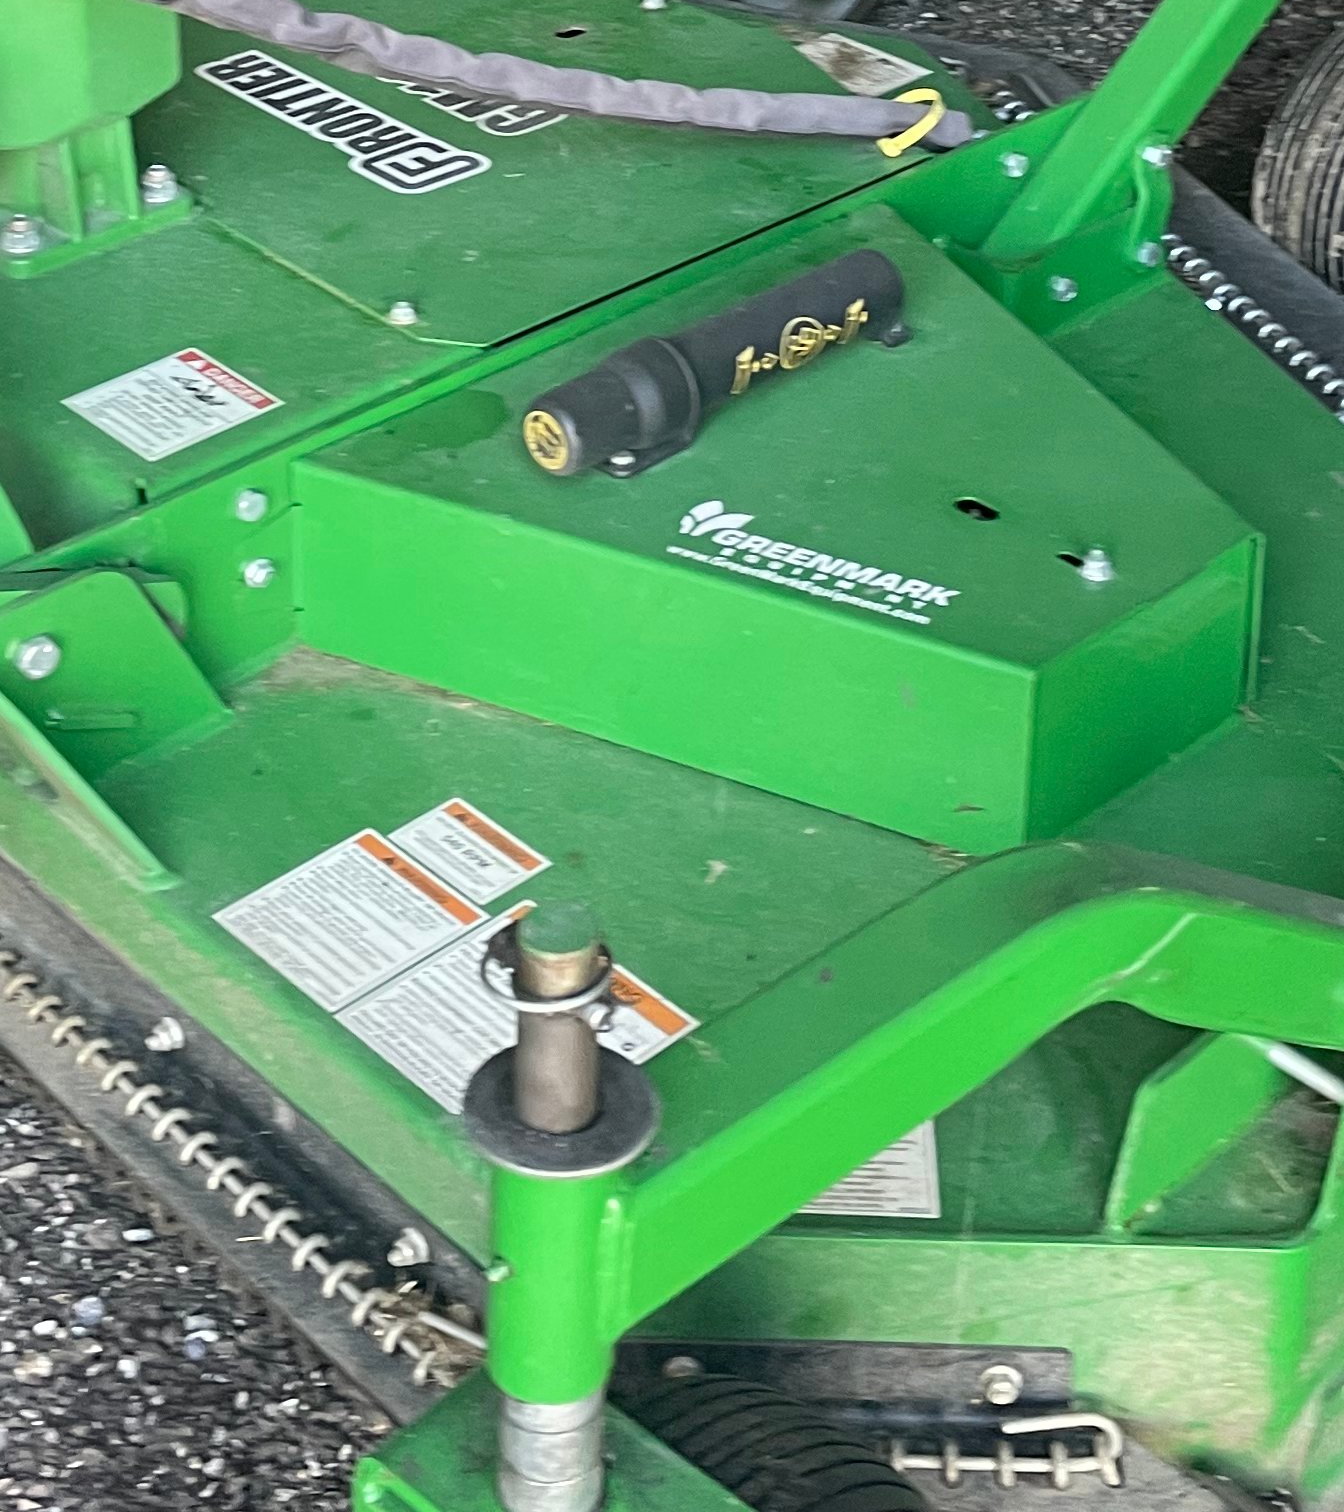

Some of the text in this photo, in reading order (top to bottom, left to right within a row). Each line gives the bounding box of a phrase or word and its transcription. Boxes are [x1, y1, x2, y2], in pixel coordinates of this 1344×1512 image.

[205, 52, 484, 191] FRONTIER
[204, 368, 262, 405] DANGER
[711, 528, 962, 607] GREENMARK
